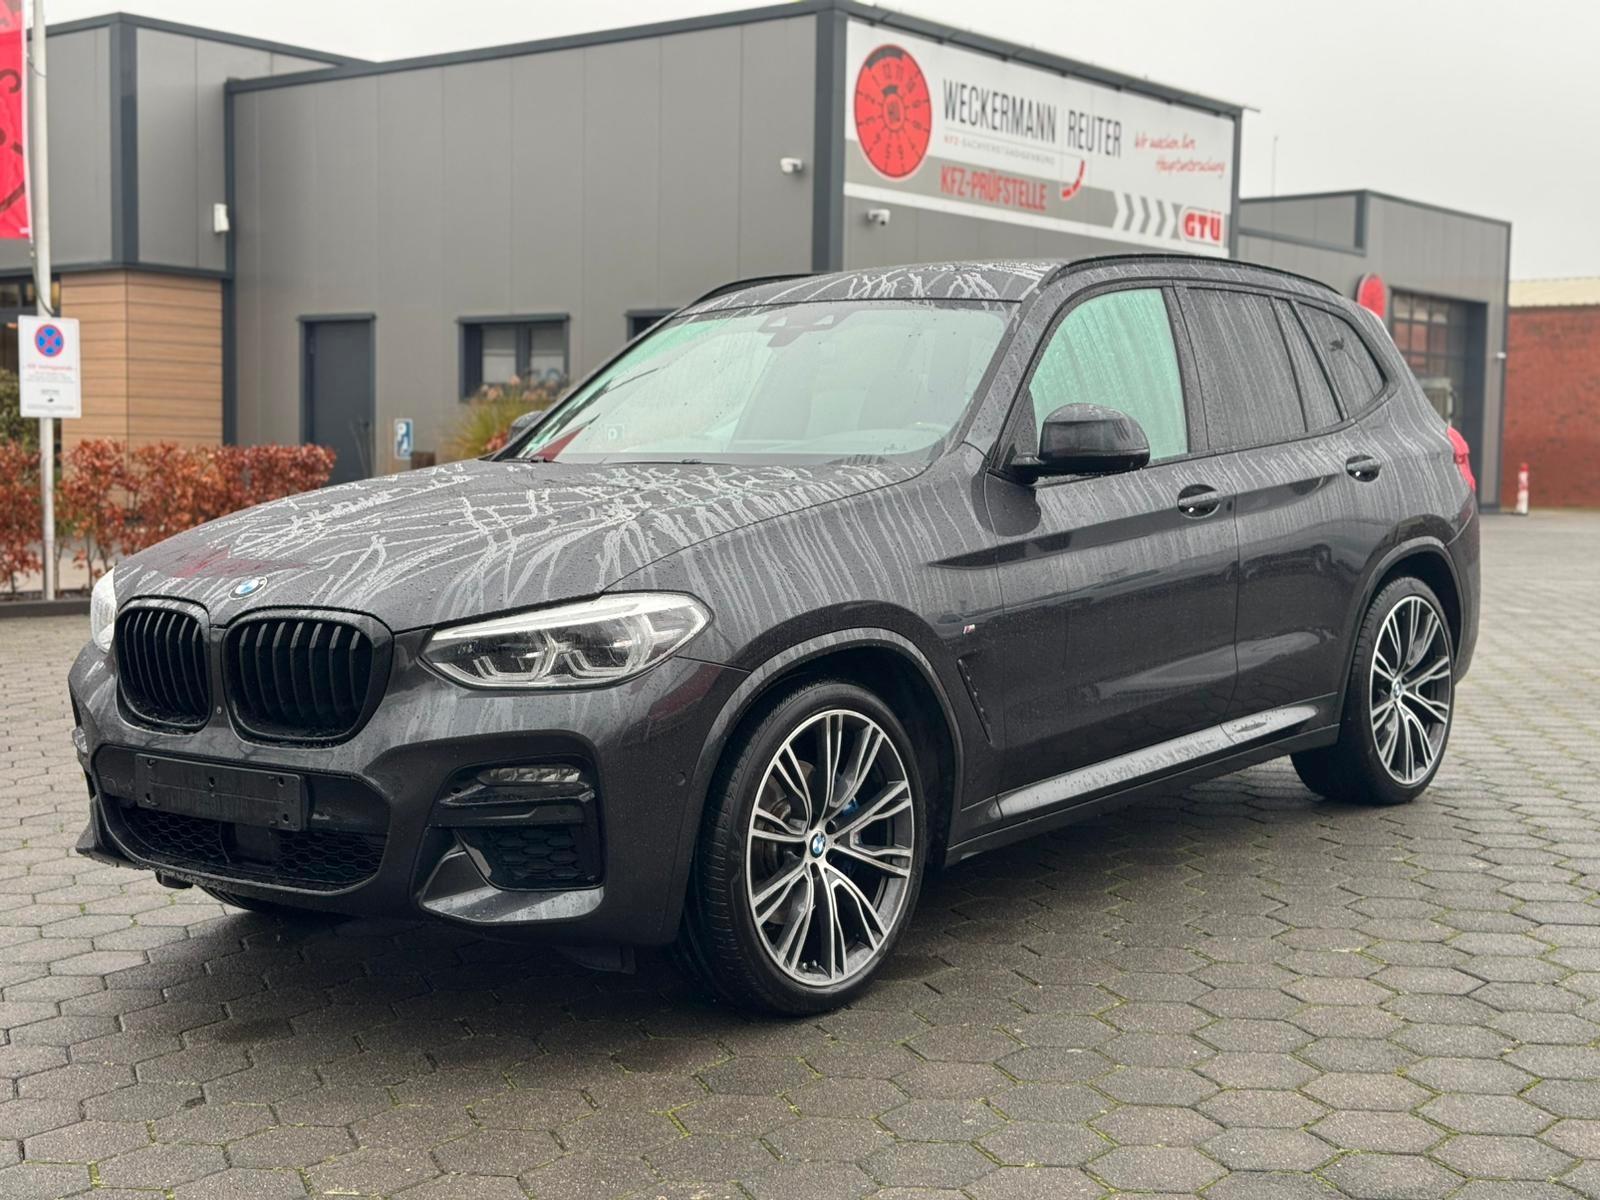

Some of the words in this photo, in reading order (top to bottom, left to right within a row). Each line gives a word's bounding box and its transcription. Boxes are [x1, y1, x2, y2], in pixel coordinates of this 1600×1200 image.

[943, 78, 1057, 144] WECKERMANN
[1067, 109, 1121, 158] REUTER
[940, 164, 1047, 212] KFZ-PRÜFSTELLE
[1184, 210, 1221, 241] GTÜ
